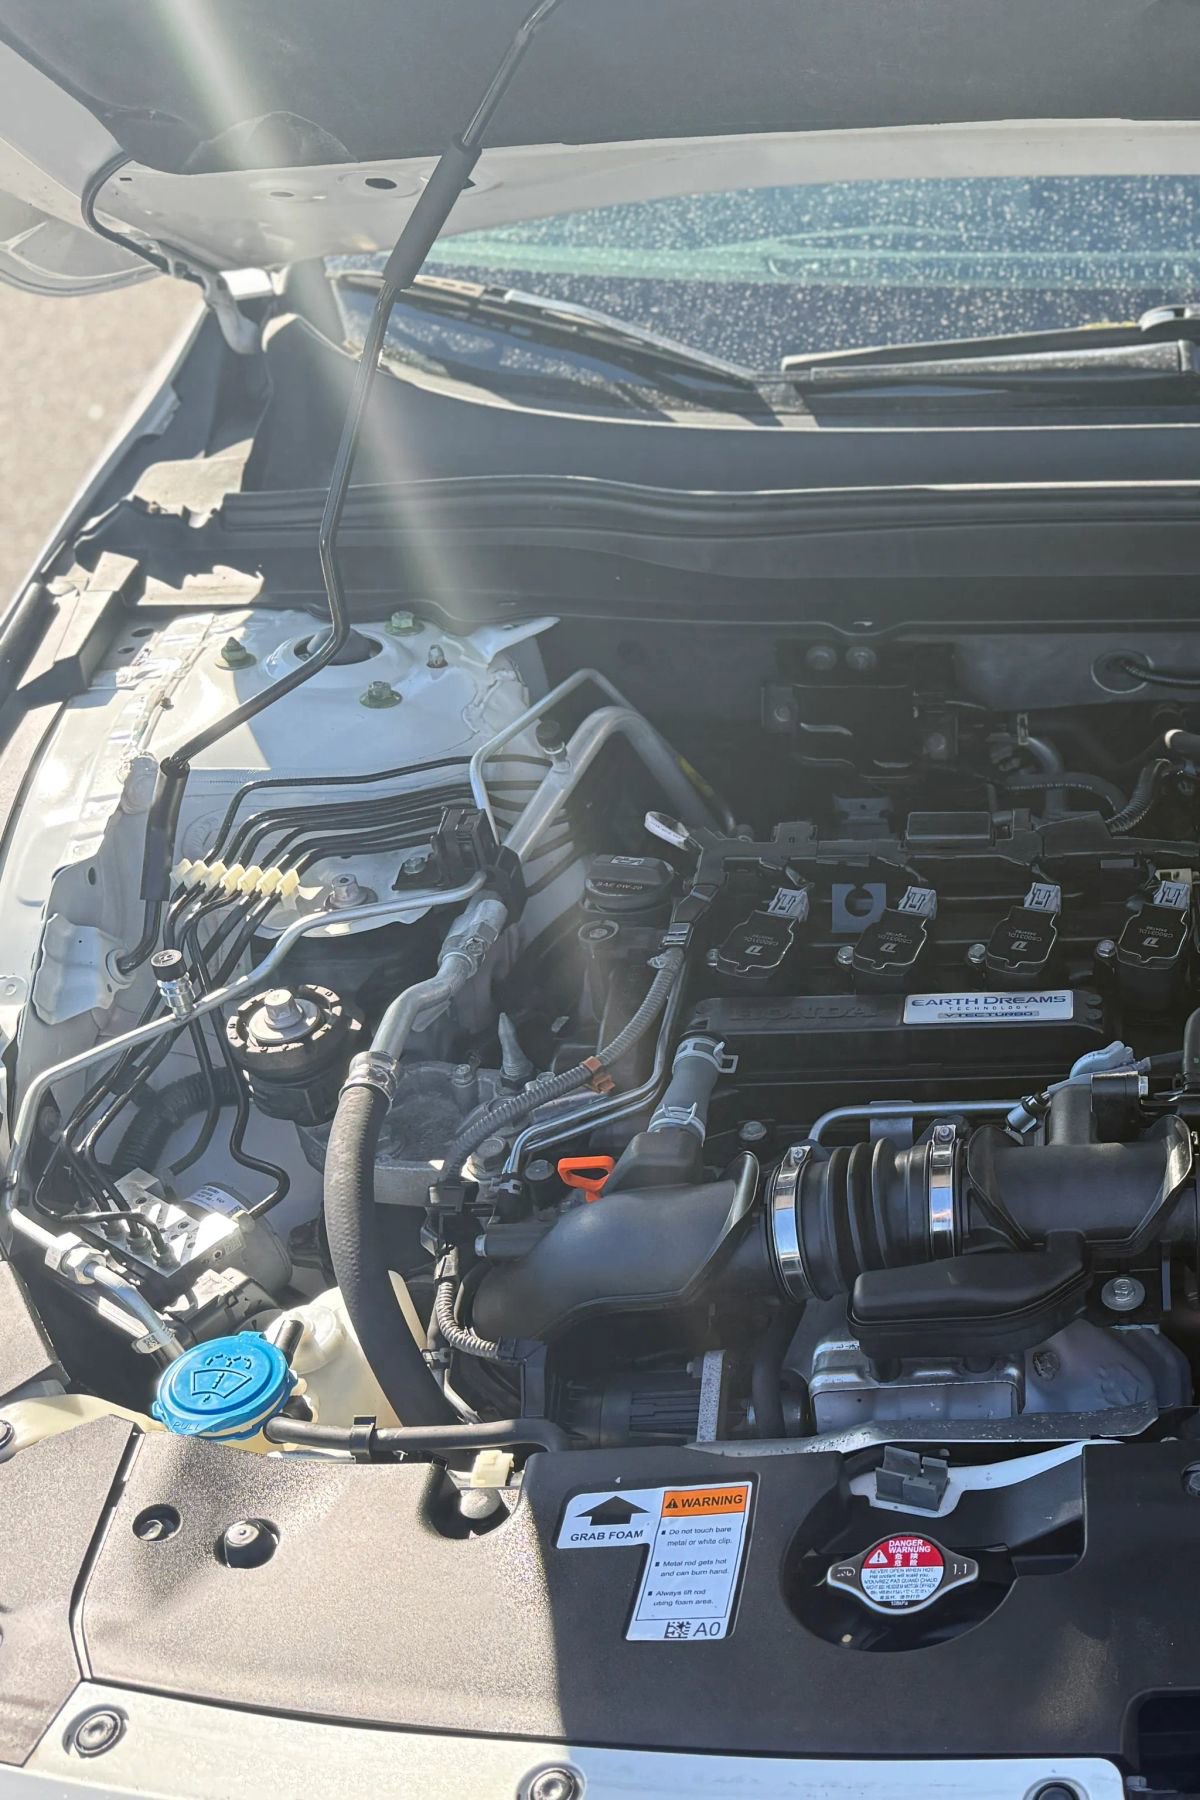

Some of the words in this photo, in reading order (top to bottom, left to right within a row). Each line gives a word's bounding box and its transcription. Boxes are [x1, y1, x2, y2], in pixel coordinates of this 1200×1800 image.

[911, 998, 978, 1007] EARTH
[983, 995, 1066, 1005] DREAMS
[681, 1494, 743, 1508] WARNING
[570, 1532, 605, 1542] GRAB
[608, 1530, 644, 1540] FOAM
[718, 1537, 732, 1545] clip.
[889, 1539, 923, 1547] DANGER
[888, 1545, 931, 1553] WARNUNG
[953, 1564, 967, 1575] 1.1
